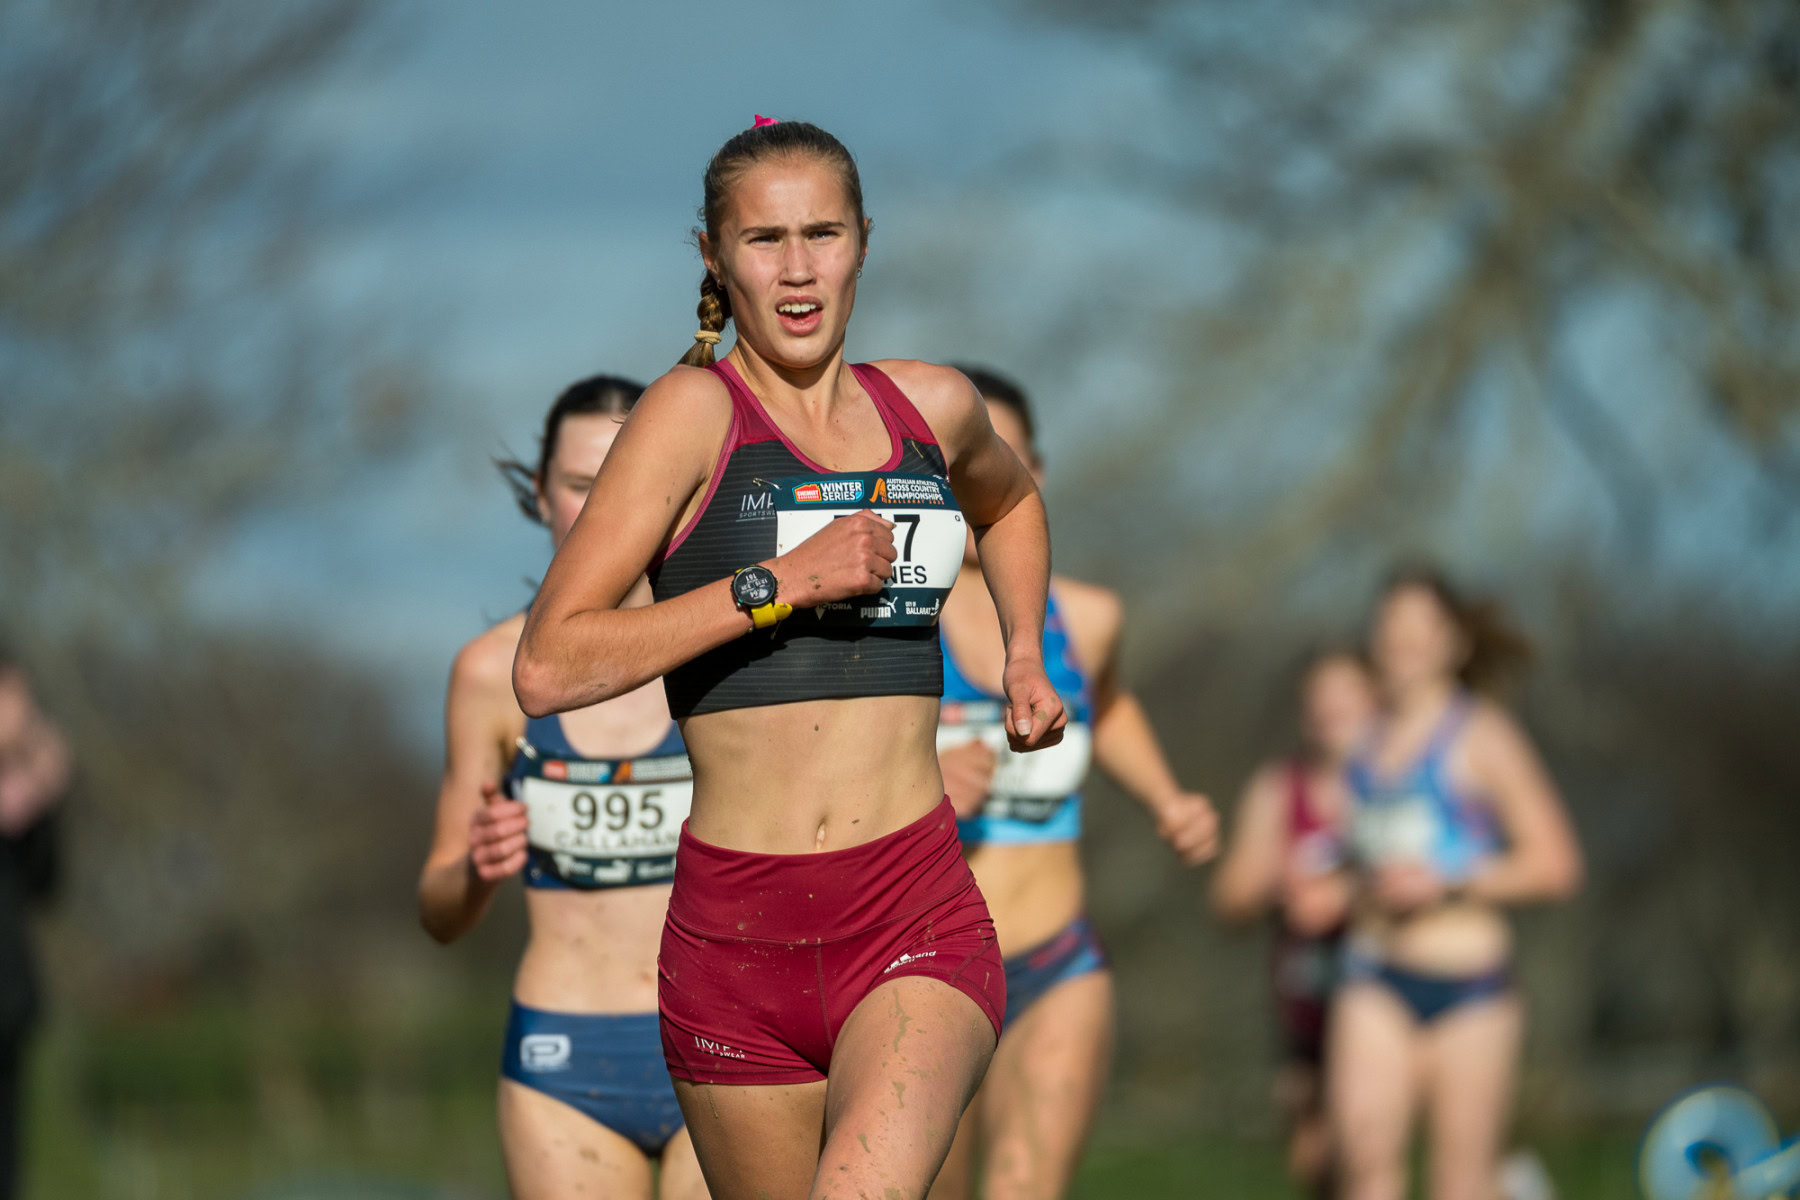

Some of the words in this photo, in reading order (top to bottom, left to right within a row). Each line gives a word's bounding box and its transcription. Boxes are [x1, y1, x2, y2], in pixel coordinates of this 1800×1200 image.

[820, 481, 863, 492] WINTER
[916, 479, 938, 487] ATHLETICS
[887, 484, 910, 492] CROSS
[910, 484, 940, 494] COUNTRY
[822, 491, 856, 501] SERIES
[887, 491, 944, 501] CHAMPIONSHIPS
[860, 607, 891, 618] PUMA
[572, 790, 665, 831] 995
